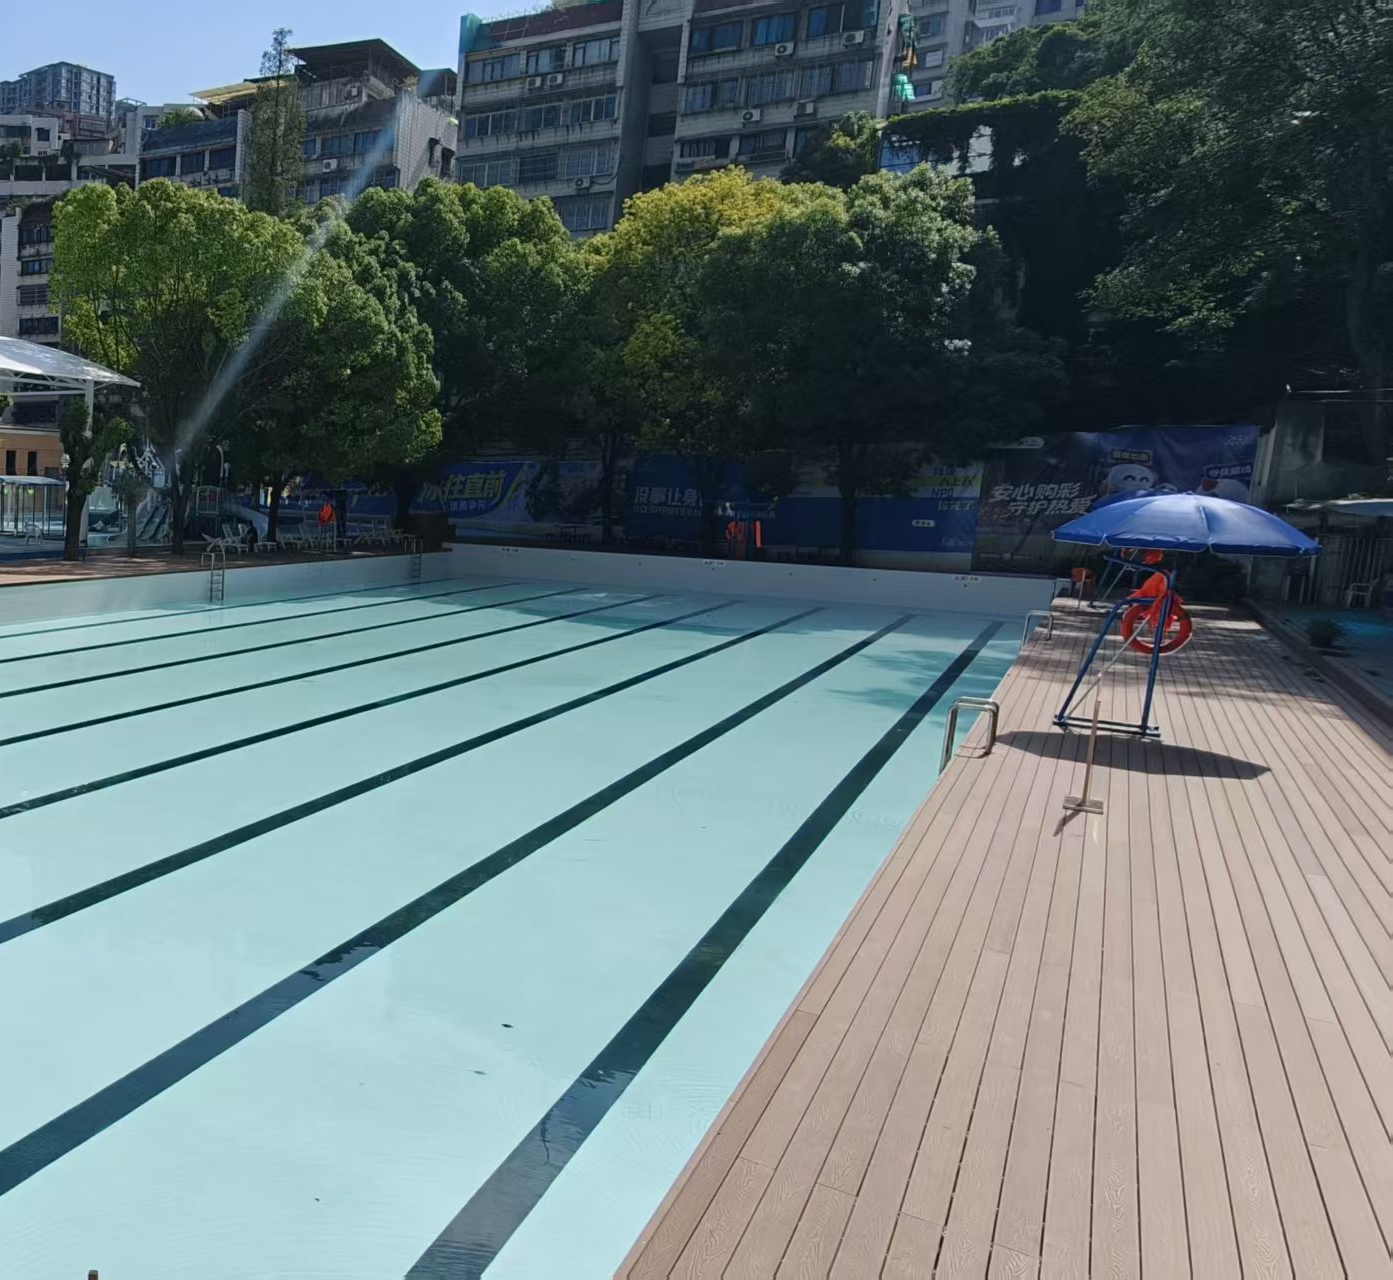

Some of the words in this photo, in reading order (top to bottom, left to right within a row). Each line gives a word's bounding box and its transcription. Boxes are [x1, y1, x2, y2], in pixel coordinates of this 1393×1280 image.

[988, 481, 1082, 503] 安心购彩
[1007, 494, 1097, 516] 守护热爱
